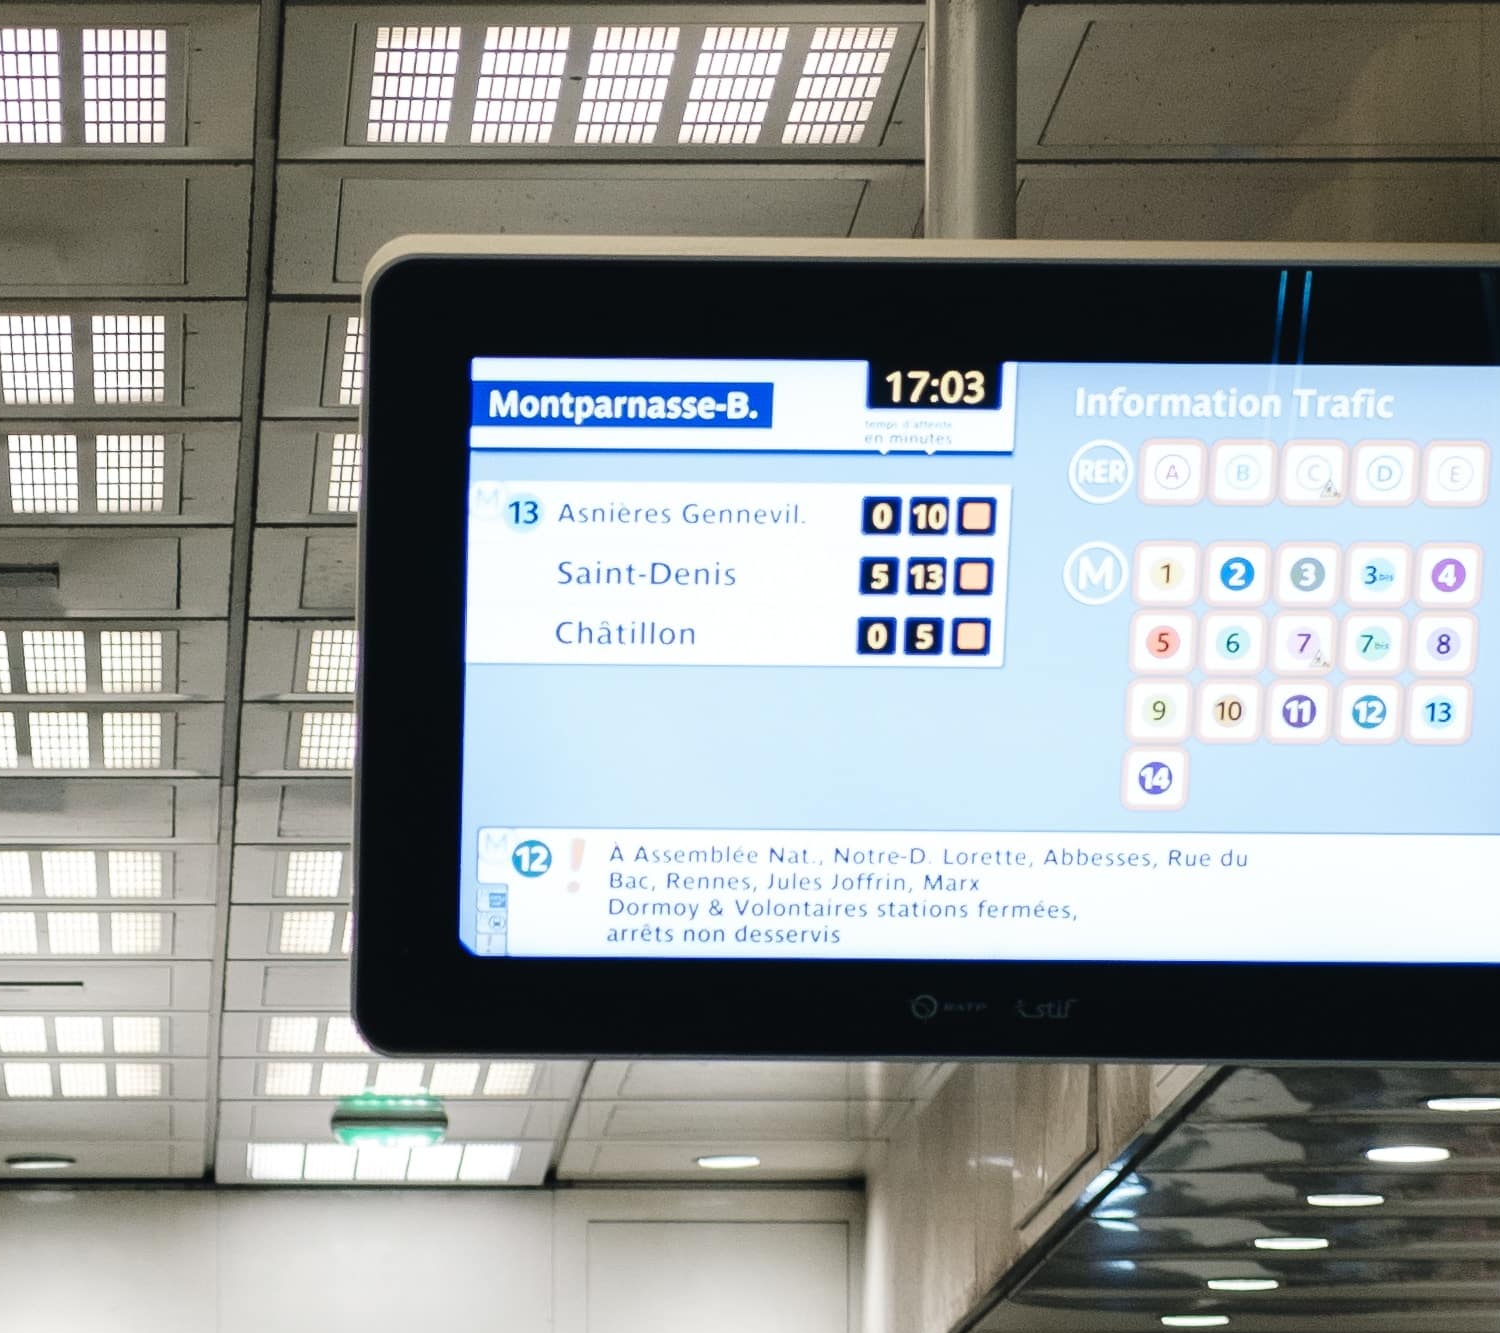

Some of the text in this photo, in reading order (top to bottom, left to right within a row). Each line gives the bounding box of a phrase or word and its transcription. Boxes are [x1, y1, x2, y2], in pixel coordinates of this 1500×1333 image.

[884, 370, 986, 405] 17:03
[489, 390, 759, 425] Montparnasse-B.
[1074, 386, 1395, 419] Information Trafic
[1078, 458, 1127, 484] RER
[508, 499, 948, 530] 13 Asnières Gennevil. 0 10
[557, 561, 945, 590] Saint-Denis 5 13
[555, 618, 934, 650] Châtillon 0 5
[514, 846, 549, 872] 12
[610, 845, 624, 863] À
[635, 845, 759, 864] Assemblée
[944, 849, 1033, 868] Lorette,
[1044, 849, 1157, 869] Abbesses,
[1168, 850, 1210, 866] Rue
[1221, 849, 1248, 867] du
[610, 873, 979, 893] Bac, Rennes, Jules Joffrin, Marx
[608, 899, 1078, 920] Dormoy & Volontaires stations fermées,
[607, 924, 841, 943] arrêts non desservis
